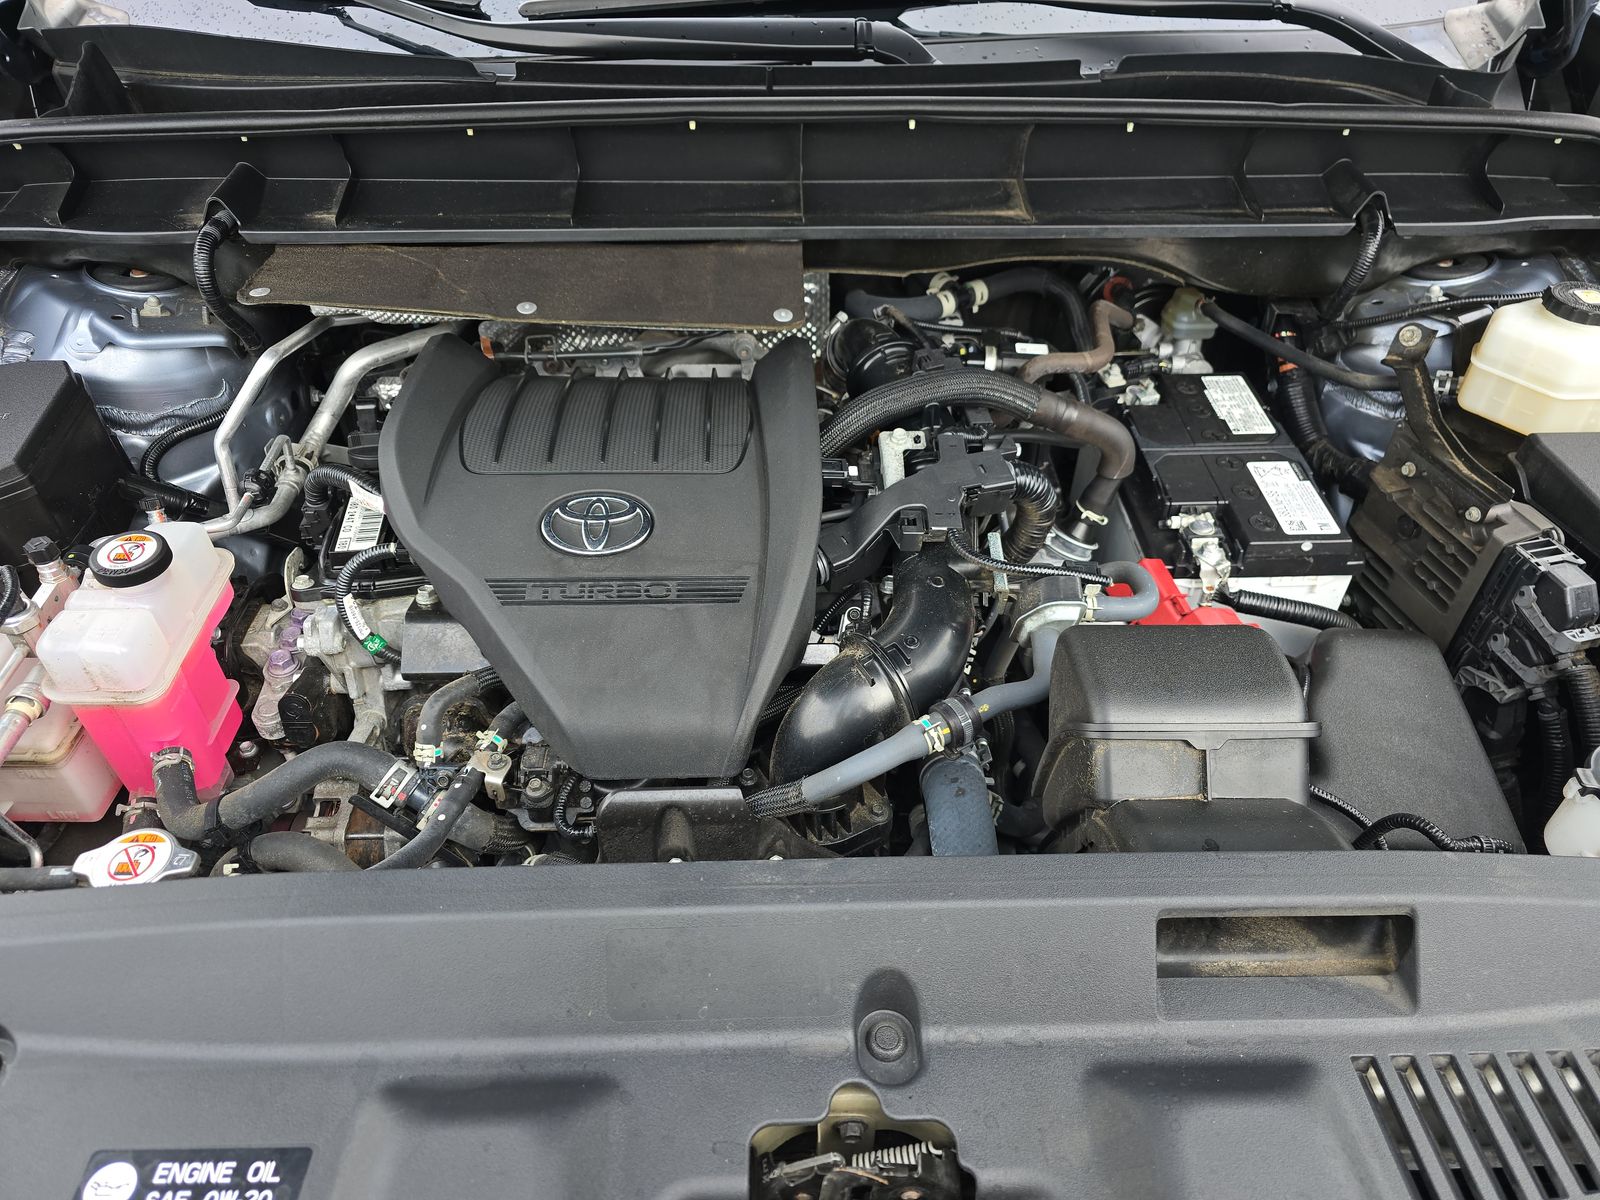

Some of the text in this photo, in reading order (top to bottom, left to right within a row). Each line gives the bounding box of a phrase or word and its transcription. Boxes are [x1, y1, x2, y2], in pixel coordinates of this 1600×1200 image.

[530, 582, 673, 600] TURBO
[152, 1160, 281, 1184] ENGINE OIL
